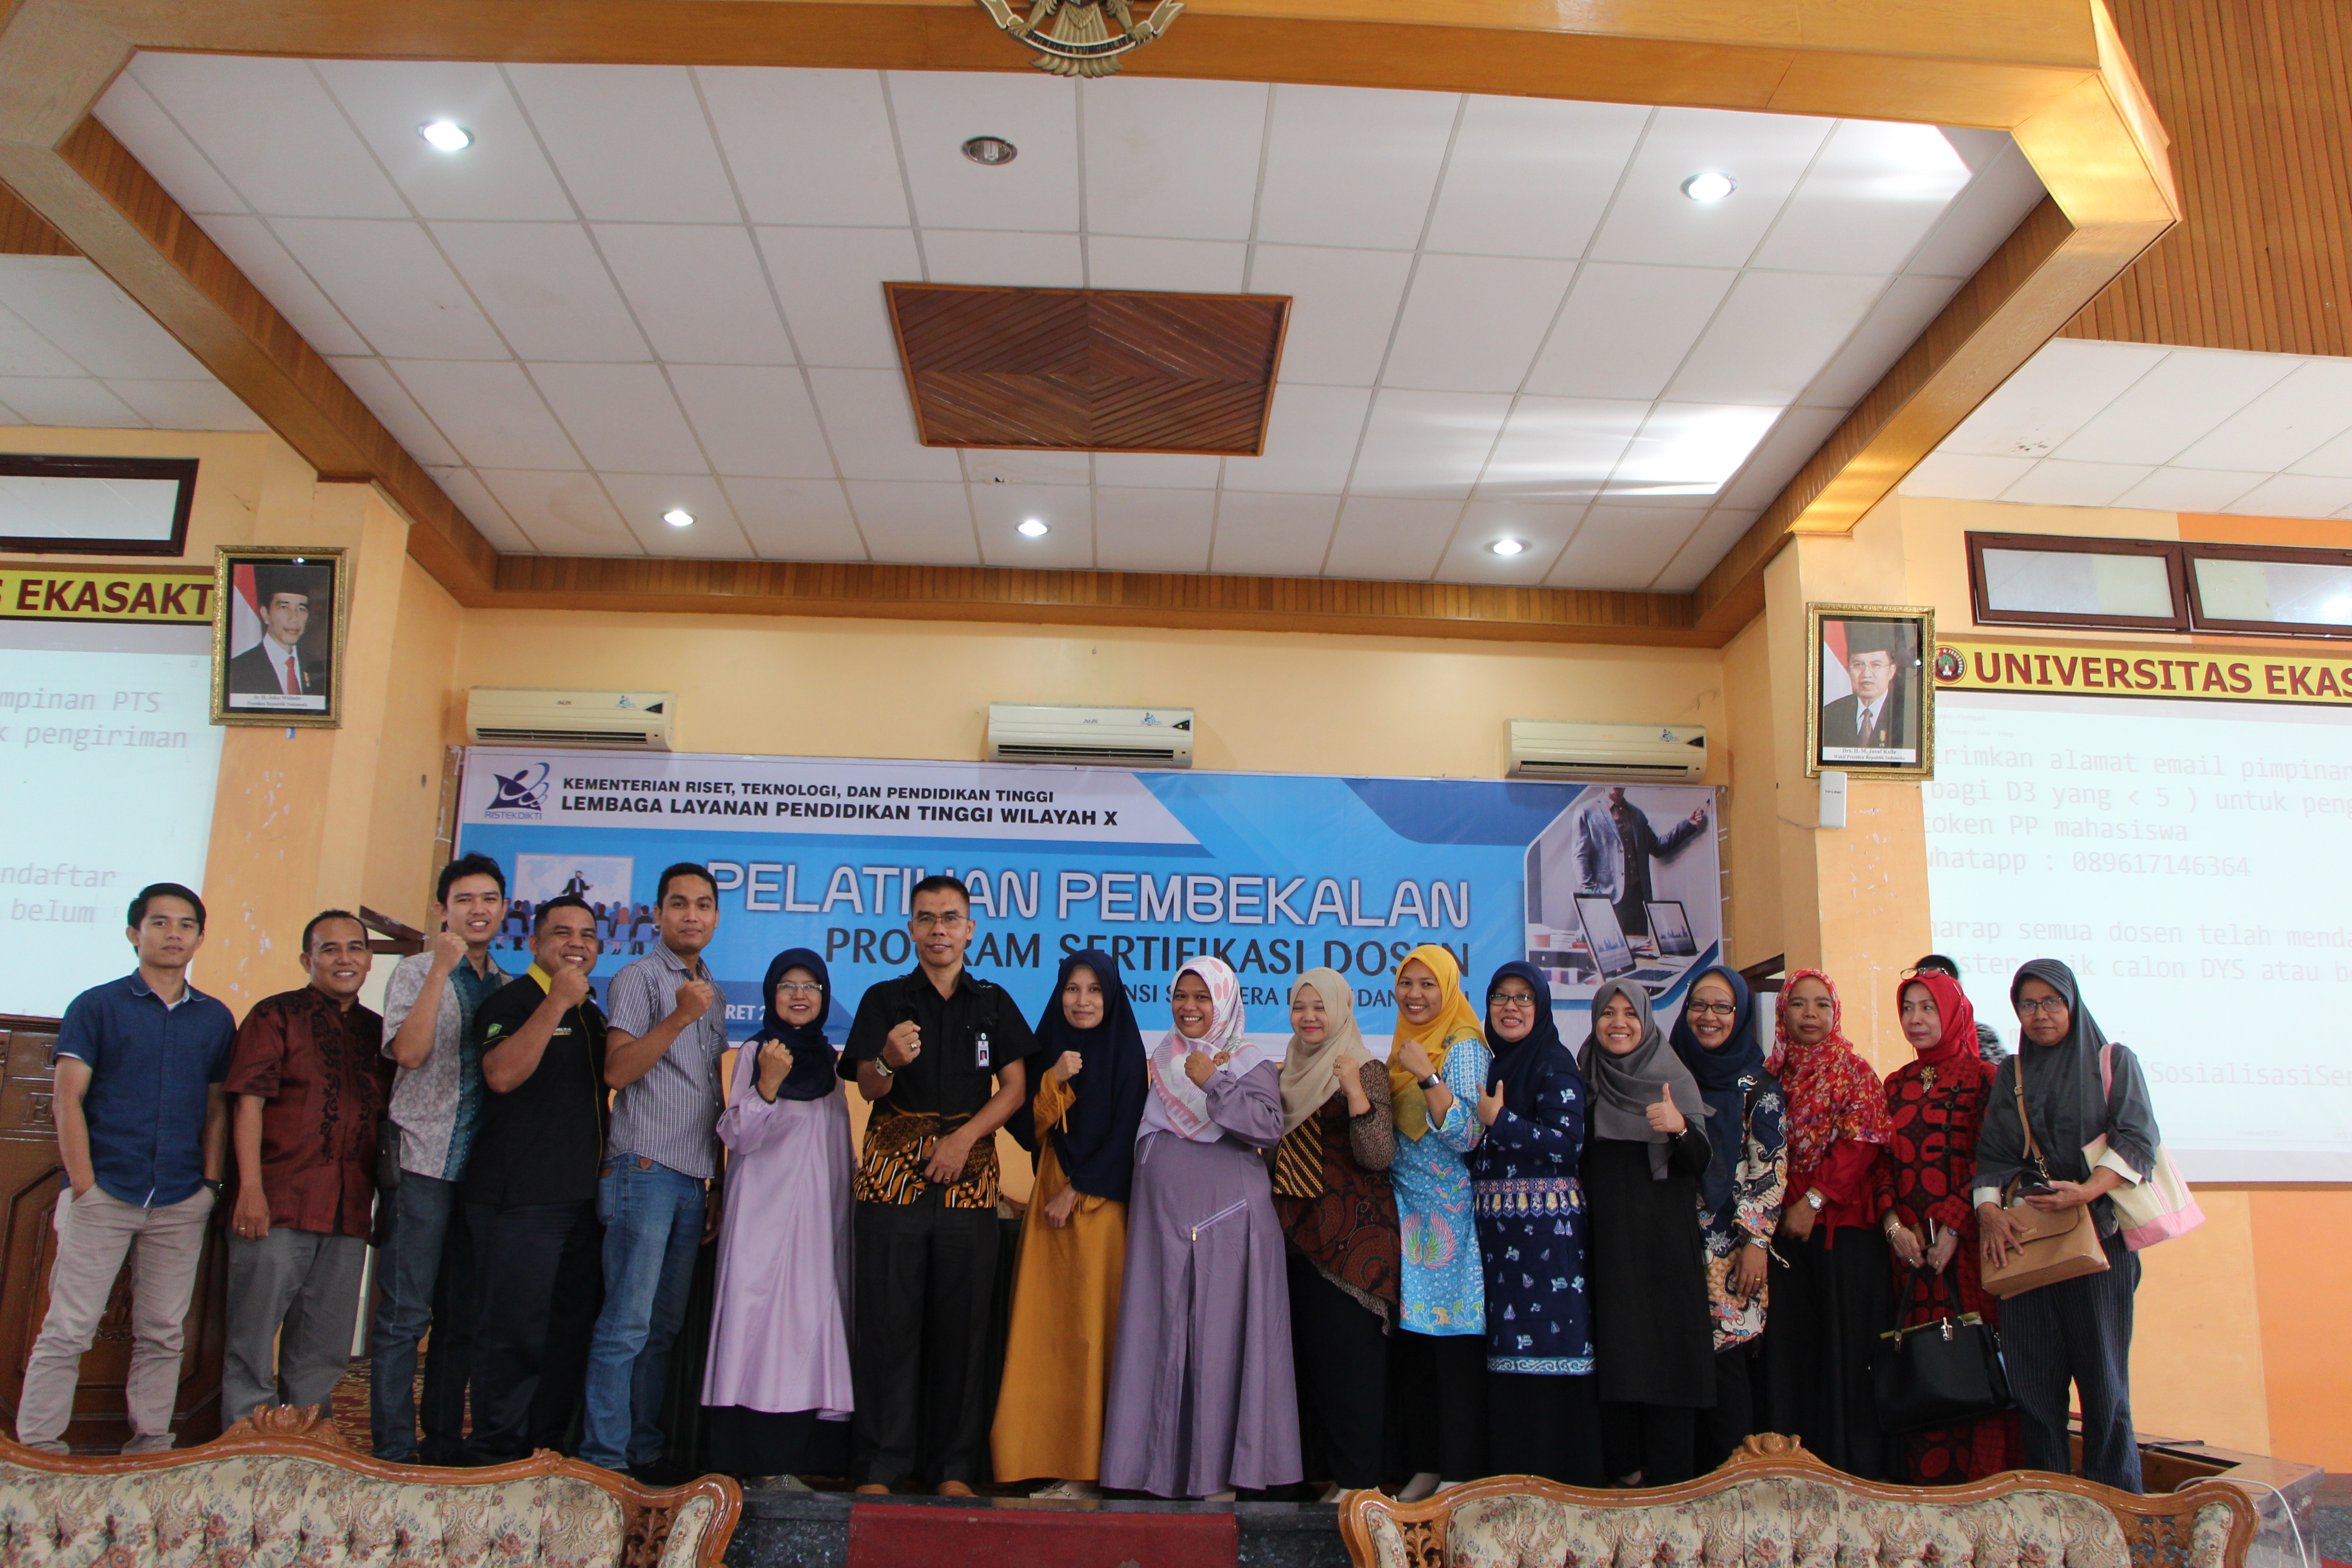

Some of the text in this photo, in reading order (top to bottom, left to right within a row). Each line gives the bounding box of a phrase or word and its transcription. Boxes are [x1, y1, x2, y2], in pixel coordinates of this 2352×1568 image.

[1974, 652, 2253, 694] UNIVERSITAS
[112, 691, 163, 713] PTS
[24, 724, 188, 751] pengiriman
[2050, 749, 2139, 772] alamat
[2153, 755, 2226, 776] email
[563, 778, 1054, 803] KEMENTERIAN RISET, TEKNOLOGI, DAN PENDIDIKAN TINGGI
[2006, 781, 2036, 802] D3
[2052, 786, 2112, 811] yang
[2157, 787, 2170, 807] 5
[2215, 790, 2288, 812] untuk
[485, 811, 542, 820] RISTEKDIKTI
[562, 796, 1117, 826] LEMBAGA LAYANAN PENDIDIKAN TINGGI WILAYAH X
[2010, 815, 2038, 836] PP
[2054, 817, 2188, 841] mahasiswa
[2072, 851, 2251, 877] 089617146364
[708, 862, 1469, 928] PELATIAN PEMBEKALAN
[11, 897, 96, 923] belum
[2019, 922, 2092, 941] semua
[2109, 920, 2183, 943] dosen
[2197, 923, 2272, 946] telah
[826, 928, 1040, 968] PROAM
[1324, 940, 1469, 977] DOSN
[2112, 955, 2186, 978] calon
[2200, 958, 2245, 980] DYS
[2262, 960, 2319, 982] atau
[725, 1004, 756, 1021] RET
